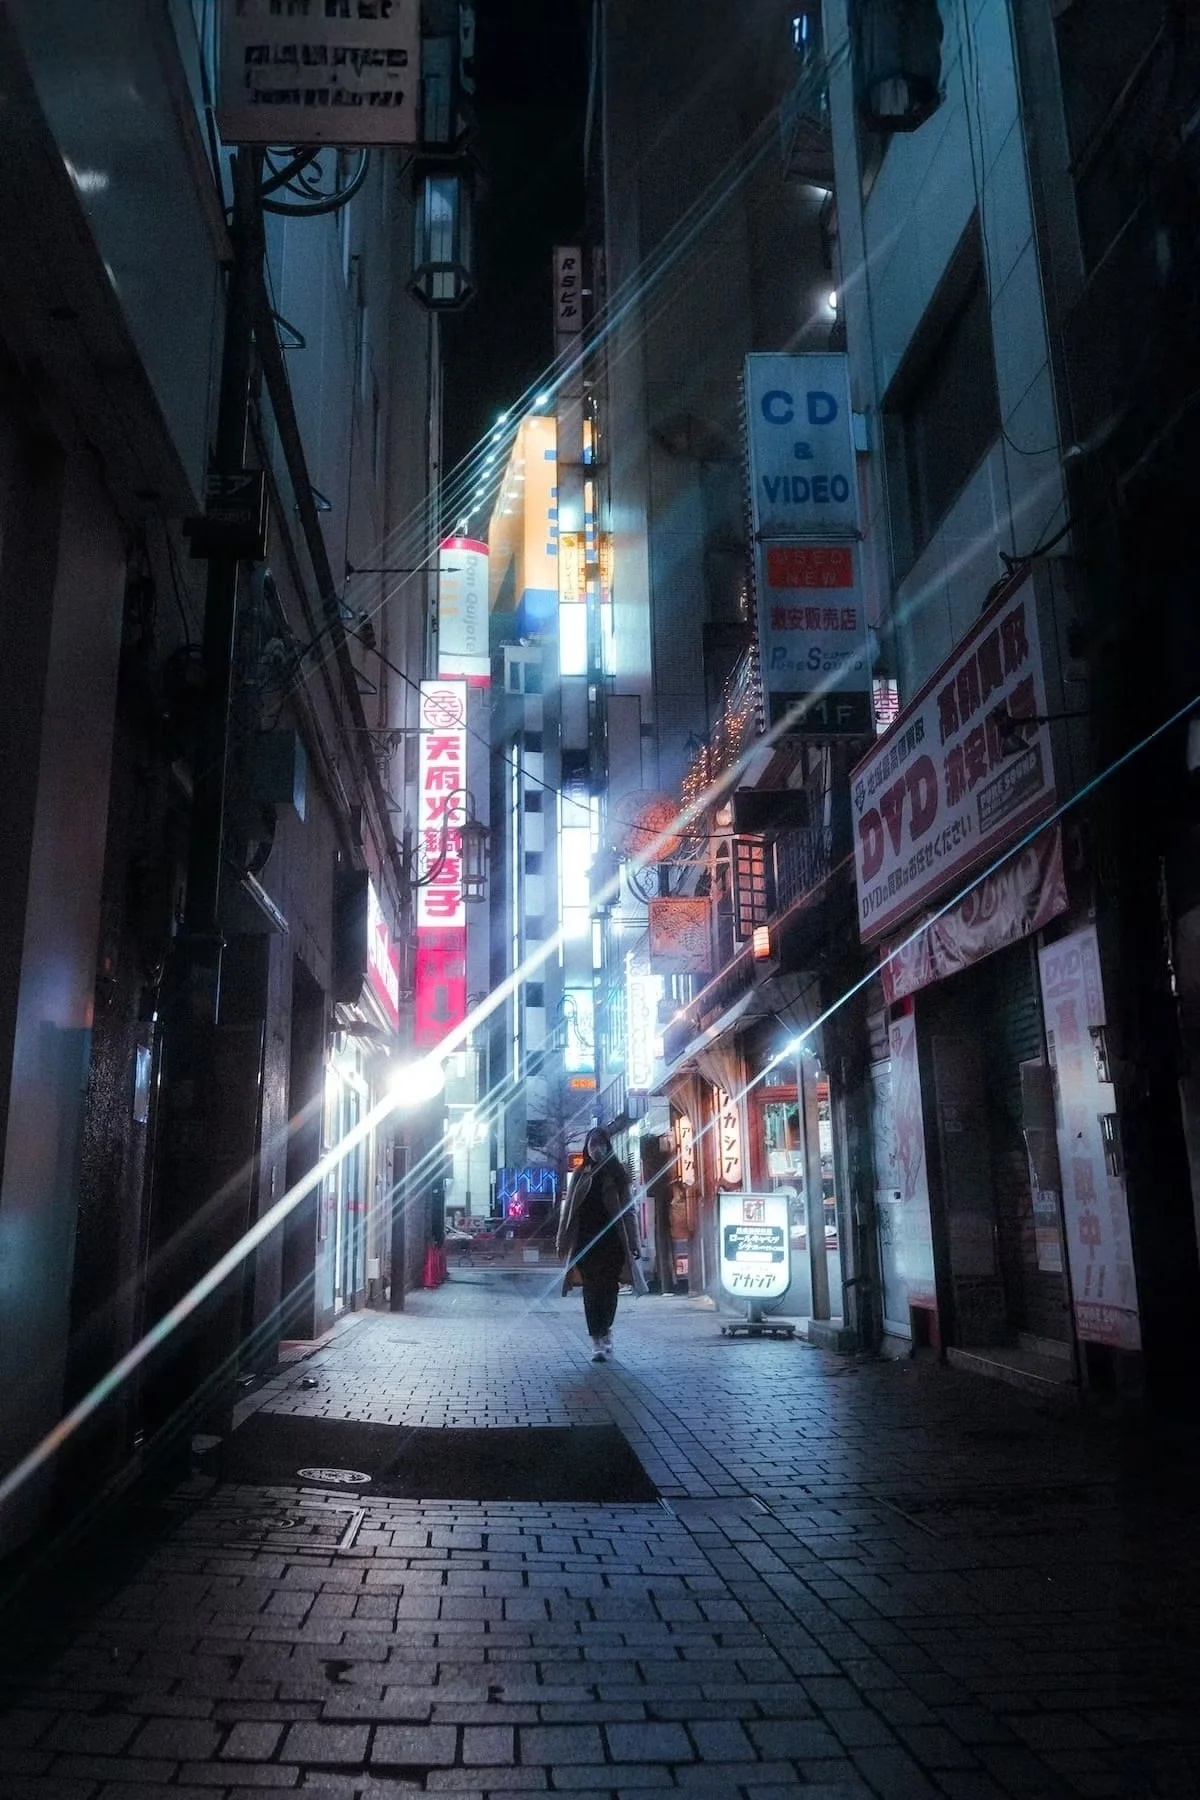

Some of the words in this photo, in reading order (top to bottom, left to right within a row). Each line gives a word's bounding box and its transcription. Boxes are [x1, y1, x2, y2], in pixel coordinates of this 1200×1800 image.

[761, 390, 838, 425] CD
[793, 442, 813, 460] &
[762, 475, 849, 503] VIDEO
[466, 556, 479, 586] Don
[786, 571, 838, 586] NEW
[462, 592, 479, 653] Quijote
[858, 754, 939, 885] DVD
[732, 1273, 776, 1288] アカシア
